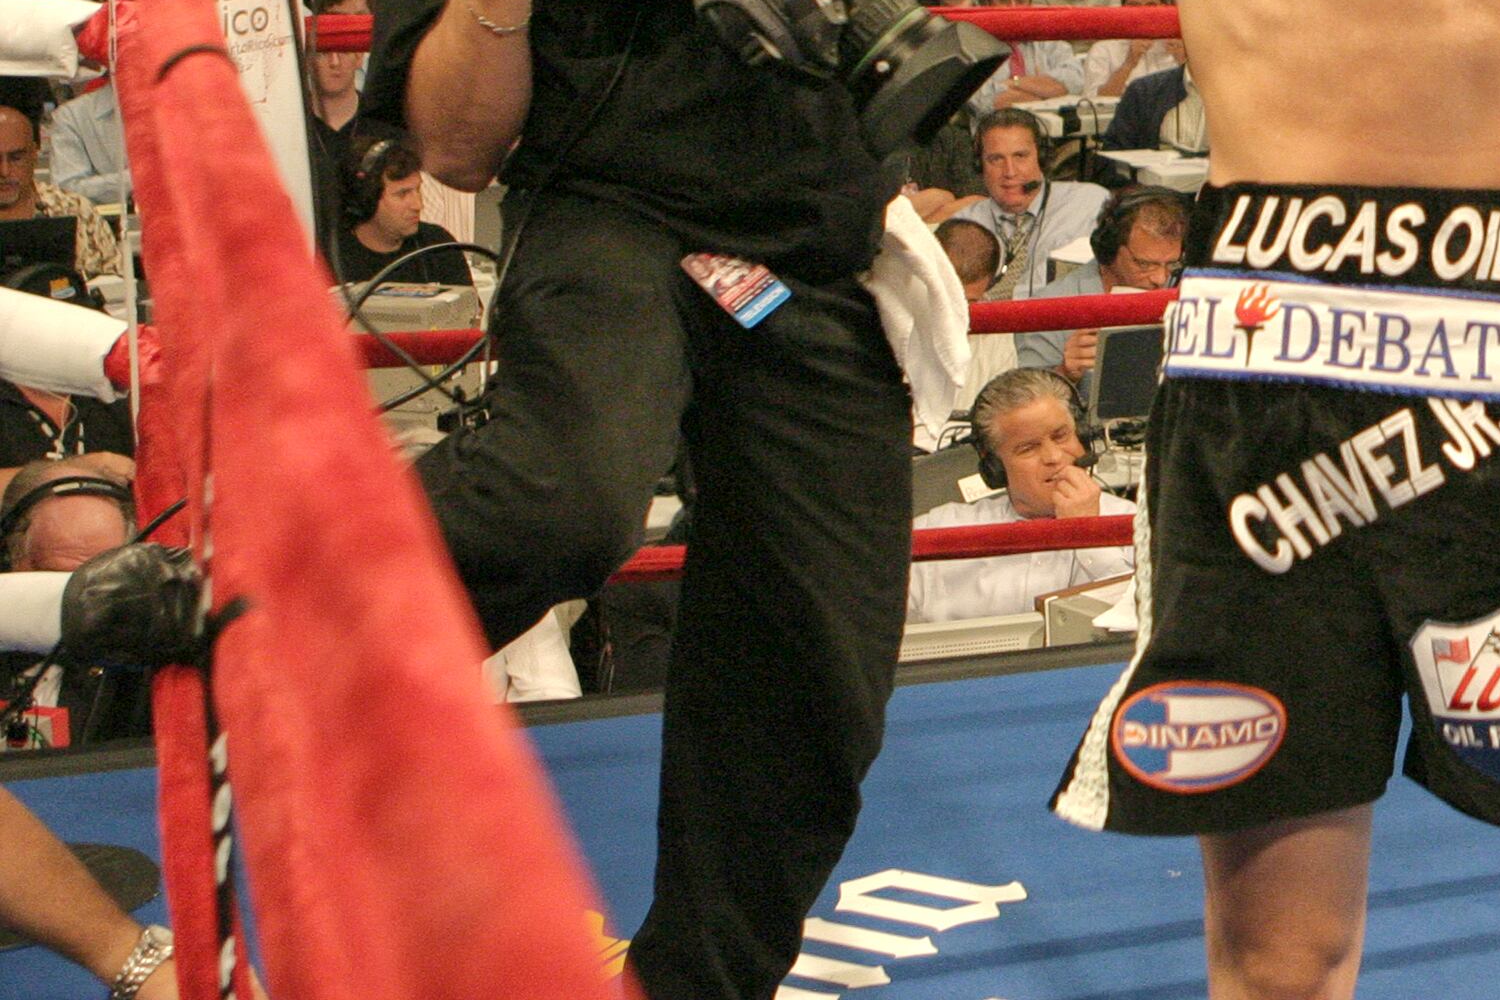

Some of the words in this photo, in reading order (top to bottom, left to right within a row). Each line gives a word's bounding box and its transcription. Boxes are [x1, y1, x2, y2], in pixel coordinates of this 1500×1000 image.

[222, 6, 269, 38] ICO
[1211, 195, 1426, 277] LUCAS
[1169, 298, 1237, 359] EL
[1230, 407, 1446, 575] CHAVEZ
[1123, 714, 1280, 749] DINAMO
[1442, 722, 1484, 749] OIL
